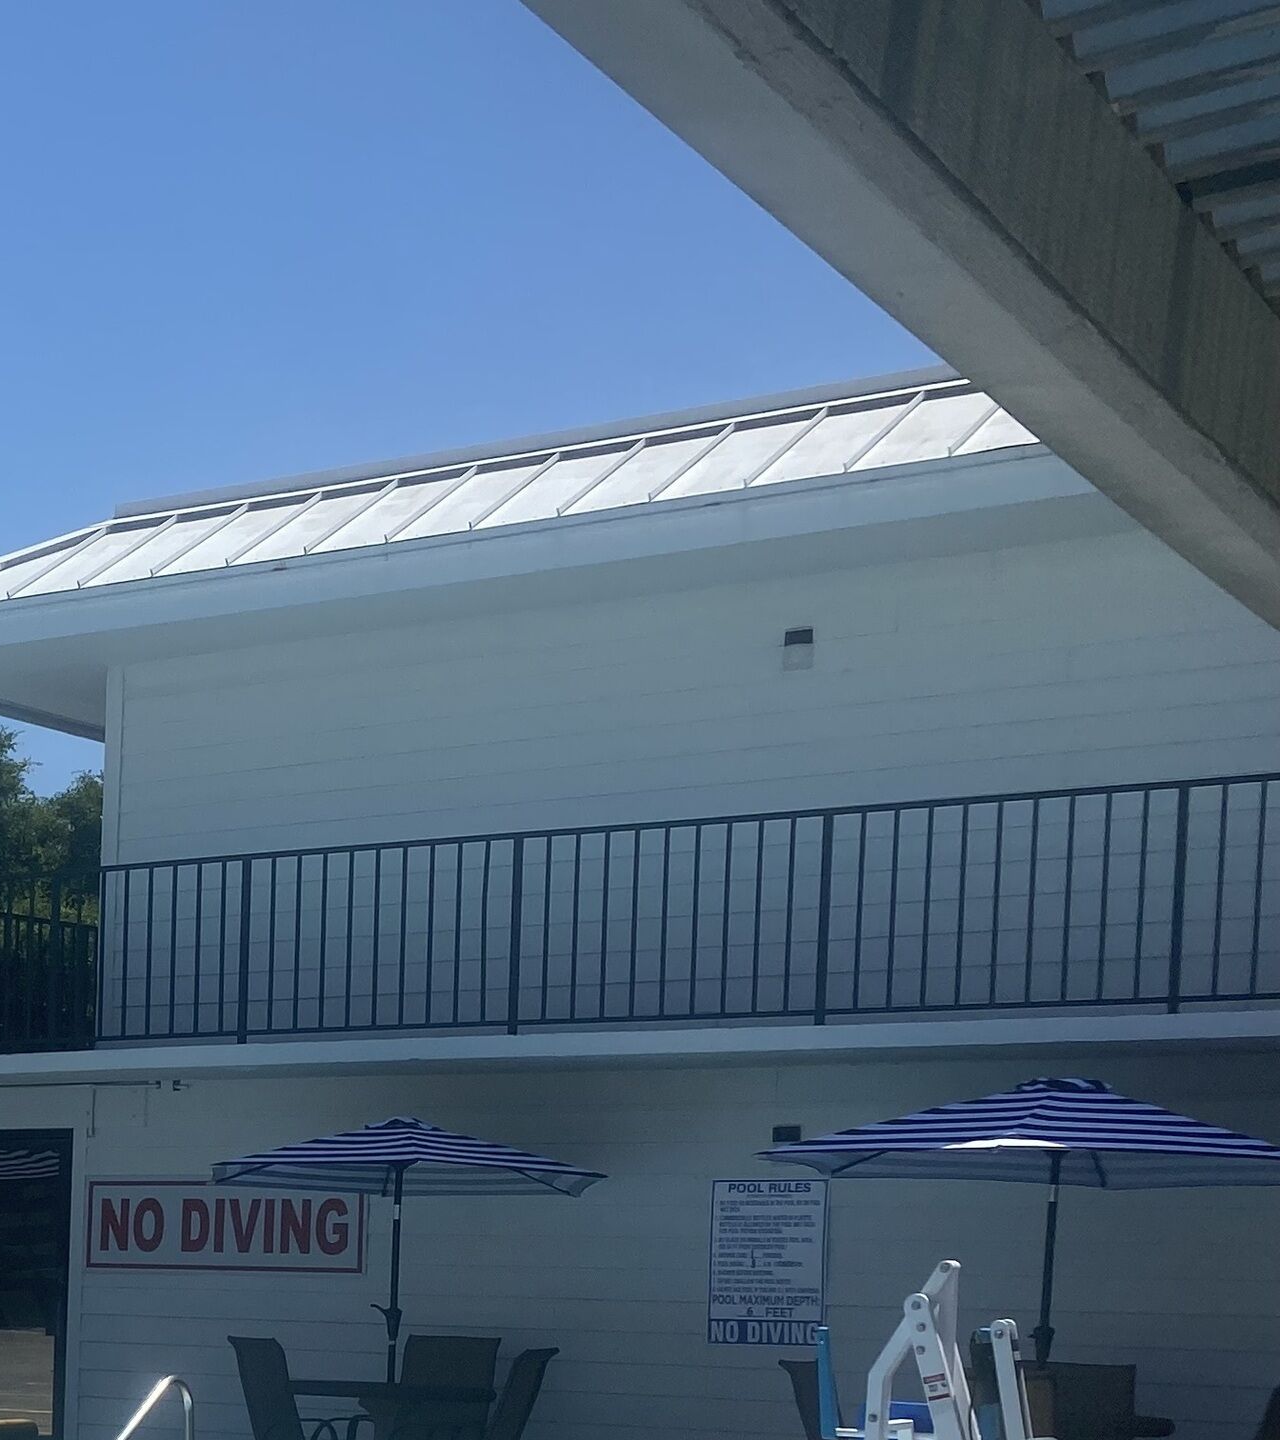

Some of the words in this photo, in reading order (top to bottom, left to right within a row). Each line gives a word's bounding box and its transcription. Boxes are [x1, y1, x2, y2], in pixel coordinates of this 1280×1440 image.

[728, 1183, 764, 1193] POOL
[768, 1182, 812, 1193] RULES
[100, 1197, 165, 1253] NO
[181, 1198, 349, 1255] DIVING
[712, 1294, 737, 1305] POOL
[740, 1294, 785, 1306] MAXIMUM
[746, 1306, 754, 1316] 6
[765, 1307, 795, 1318] FEET
[710, 1320, 739, 1342] NO
[746, 1321, 818, 1344] DIVING
